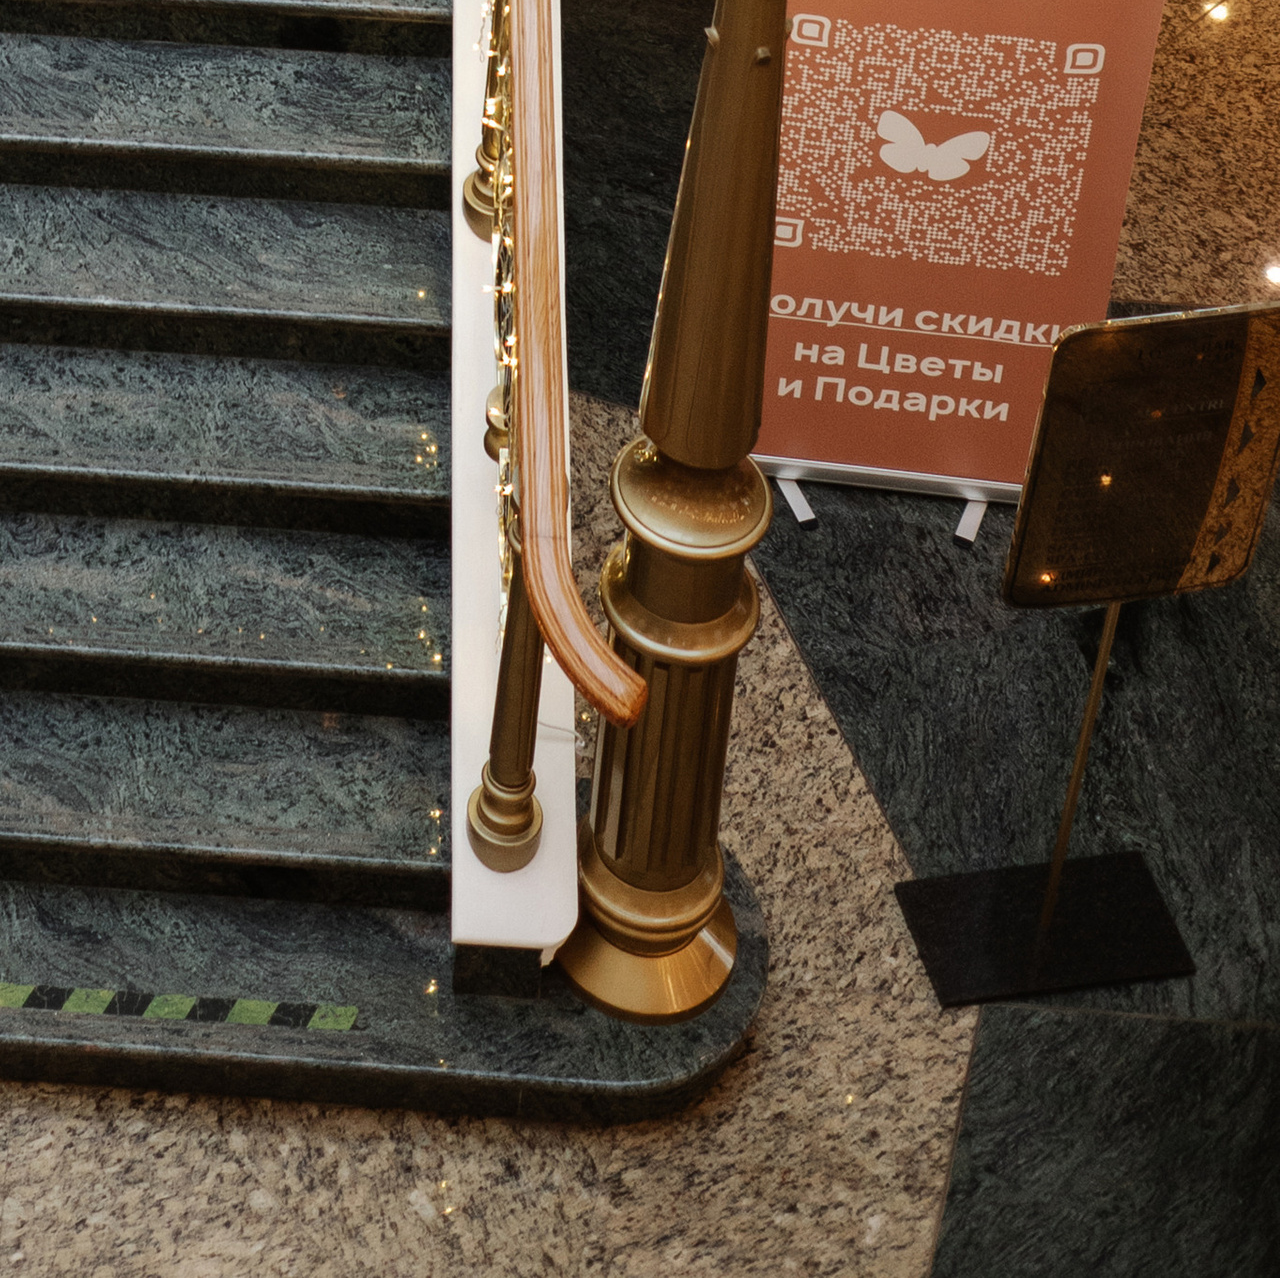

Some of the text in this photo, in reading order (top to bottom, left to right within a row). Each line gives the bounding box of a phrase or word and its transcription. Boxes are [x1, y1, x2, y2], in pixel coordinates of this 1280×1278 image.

[770, 294, 903, 328] олучи
[794, 341, 1004, 384] на Цветы
[777, 376, 1010, 422] и Подарки
